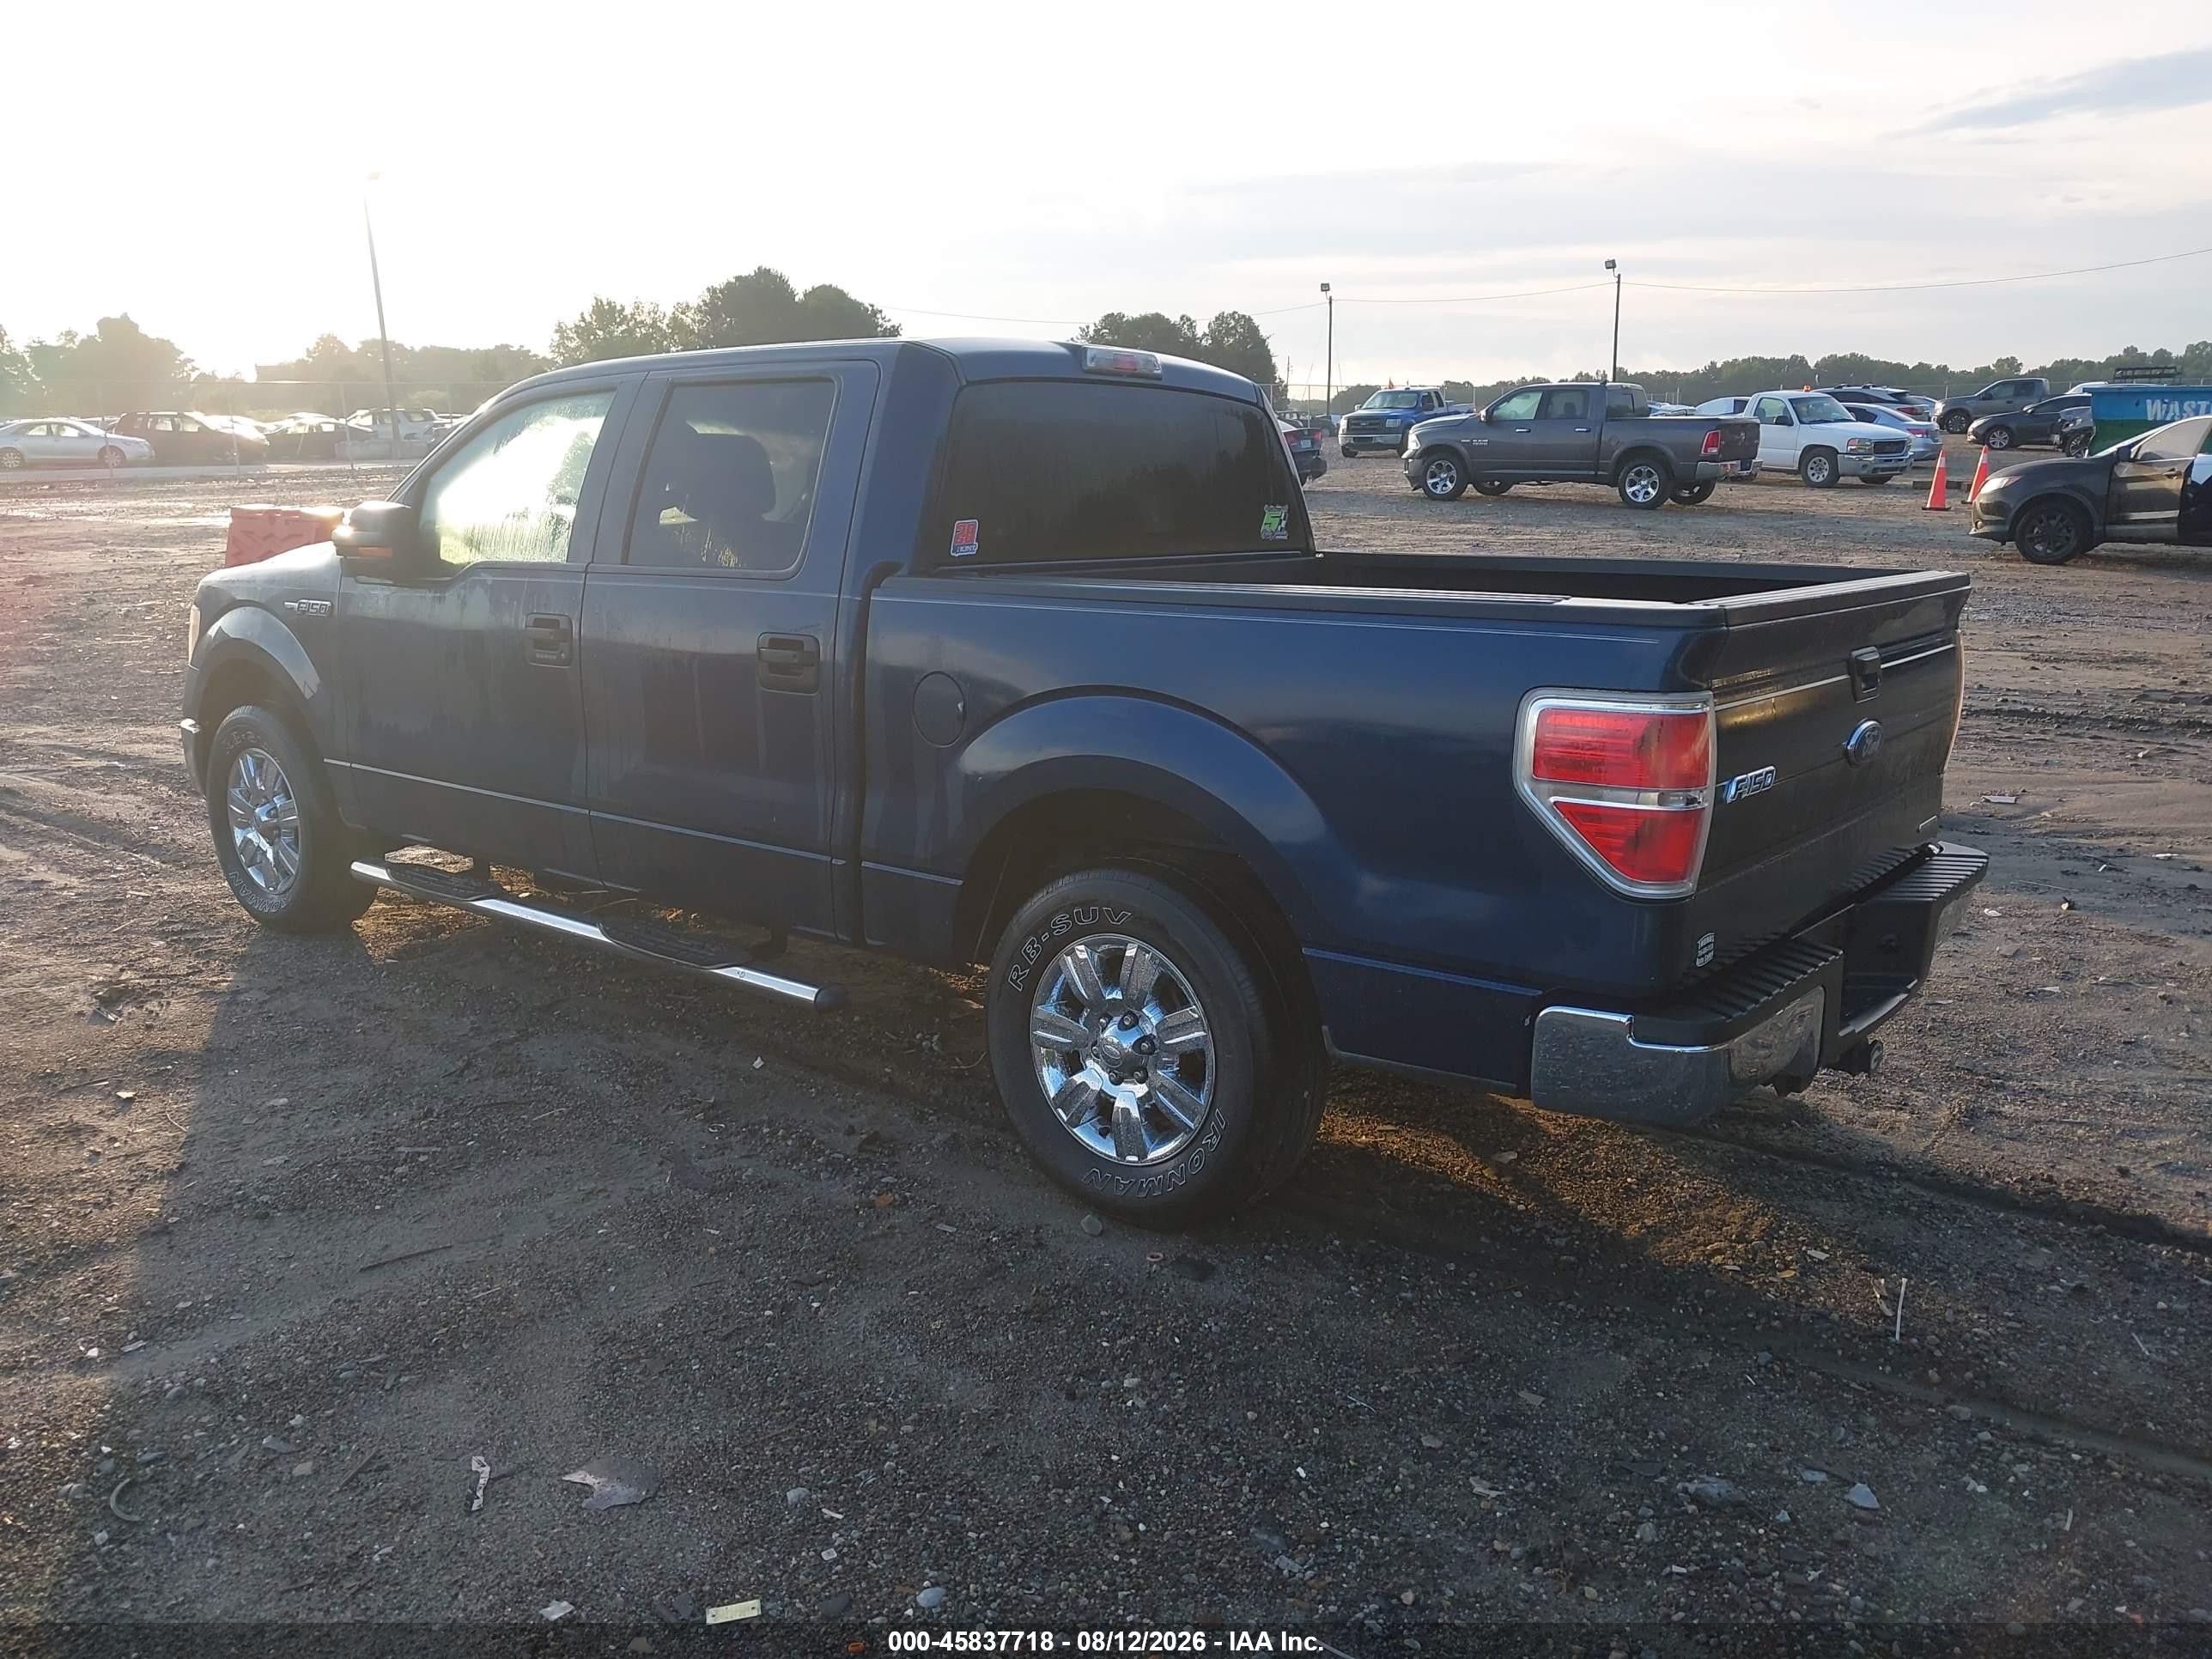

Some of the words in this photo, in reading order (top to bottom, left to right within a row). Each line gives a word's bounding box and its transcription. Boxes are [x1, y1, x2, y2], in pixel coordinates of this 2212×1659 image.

[2145, 398, 2212, 421] WAST
[1007, 906, 1133, 992] RB-SUV
[1083, 1108, 1228, 1198] IRONMAN
